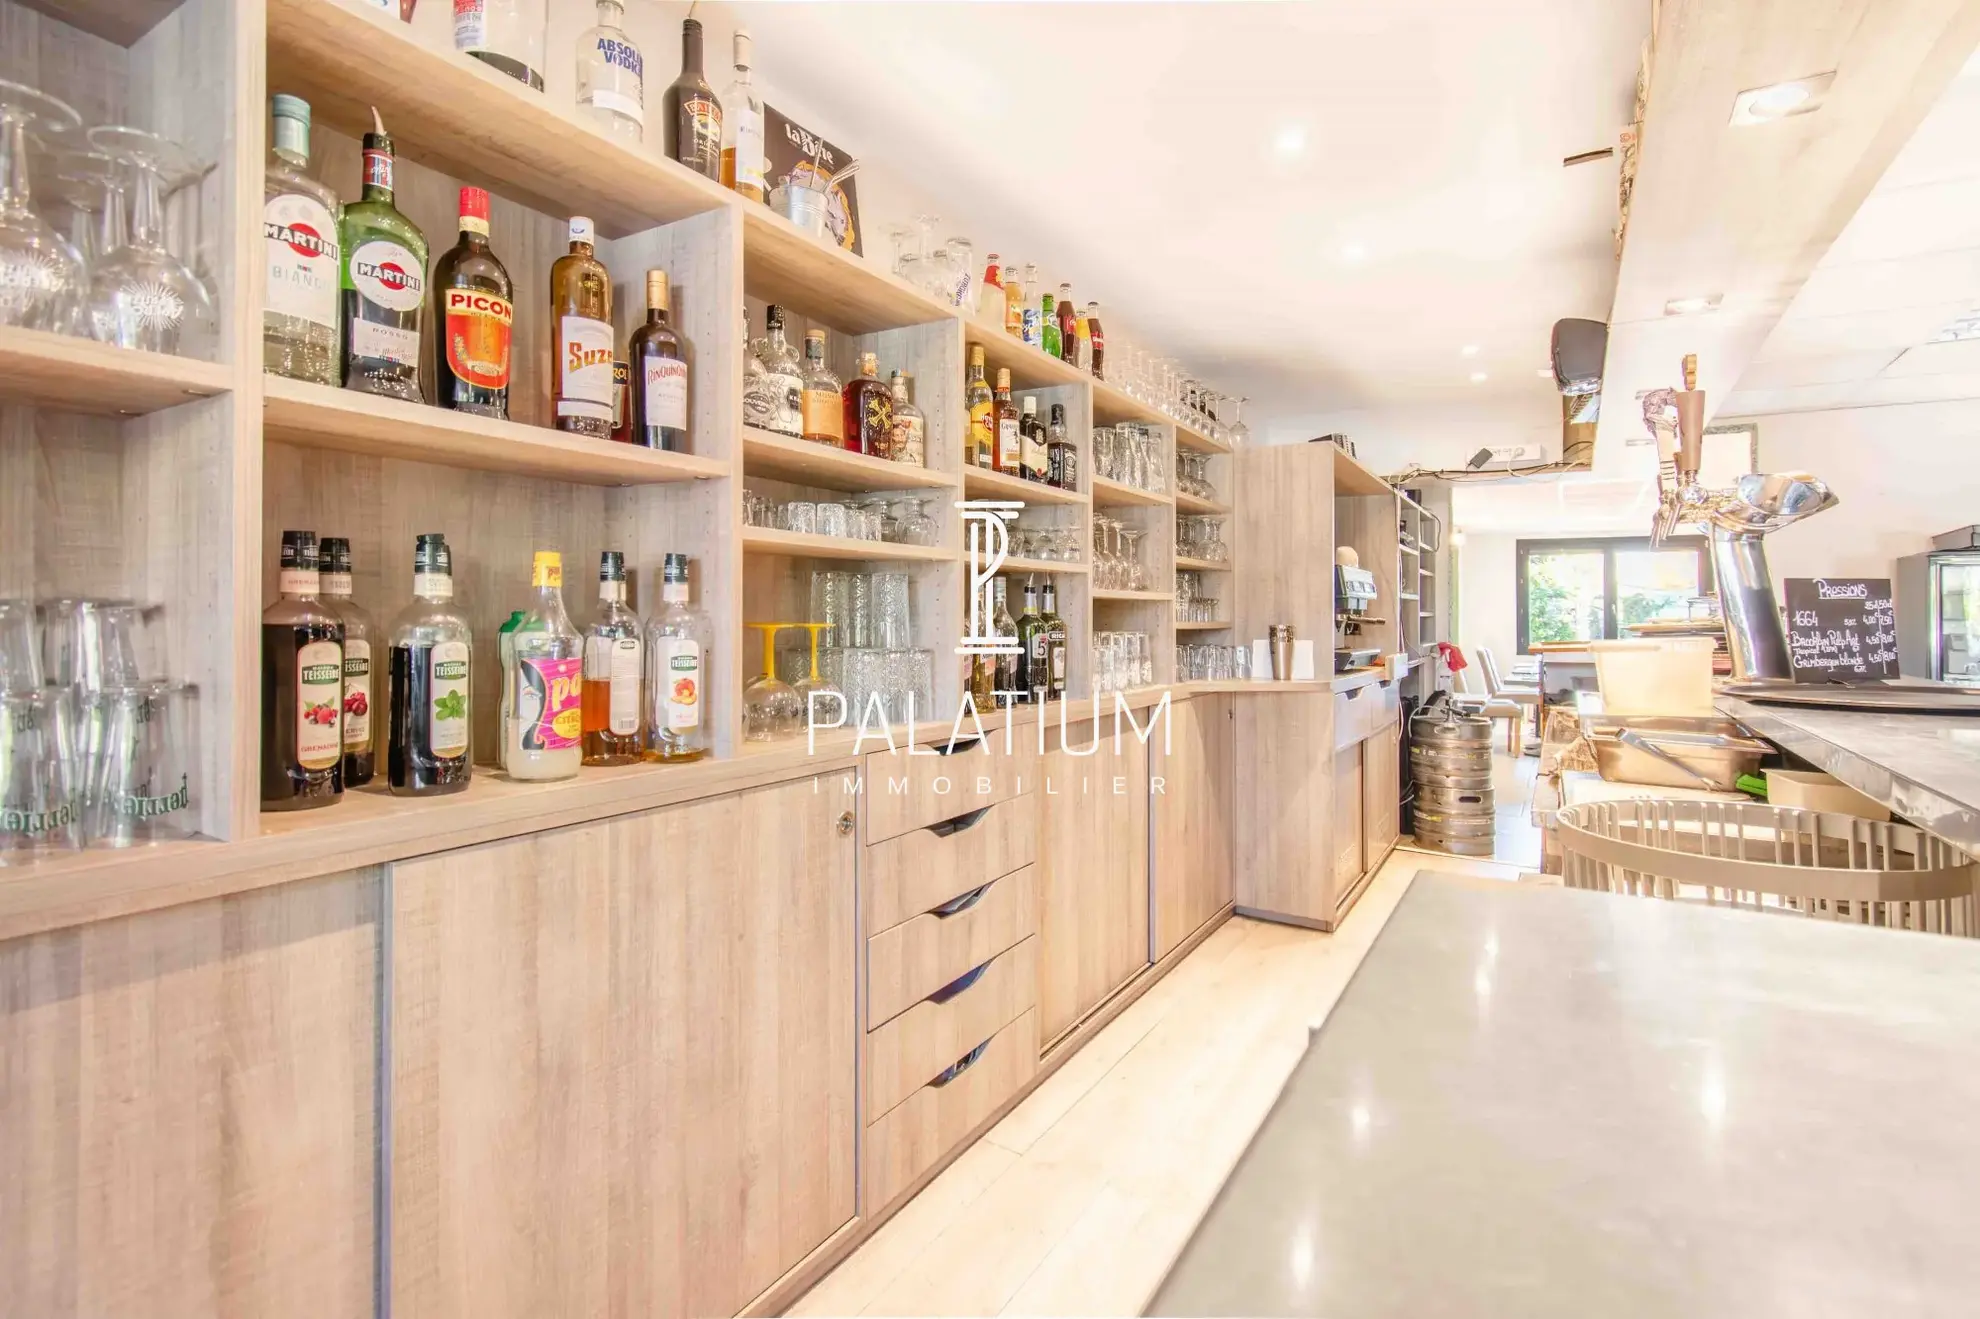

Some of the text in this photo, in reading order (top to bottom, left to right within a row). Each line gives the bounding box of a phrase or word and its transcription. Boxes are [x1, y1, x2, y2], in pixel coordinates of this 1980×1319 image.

[264, 223, 338, 261] MARTINI
[358, 262, 420, 291] MARTINI
[451, 293, 511, 320] PICON
[1792, 610, 1819, 626] 1664
